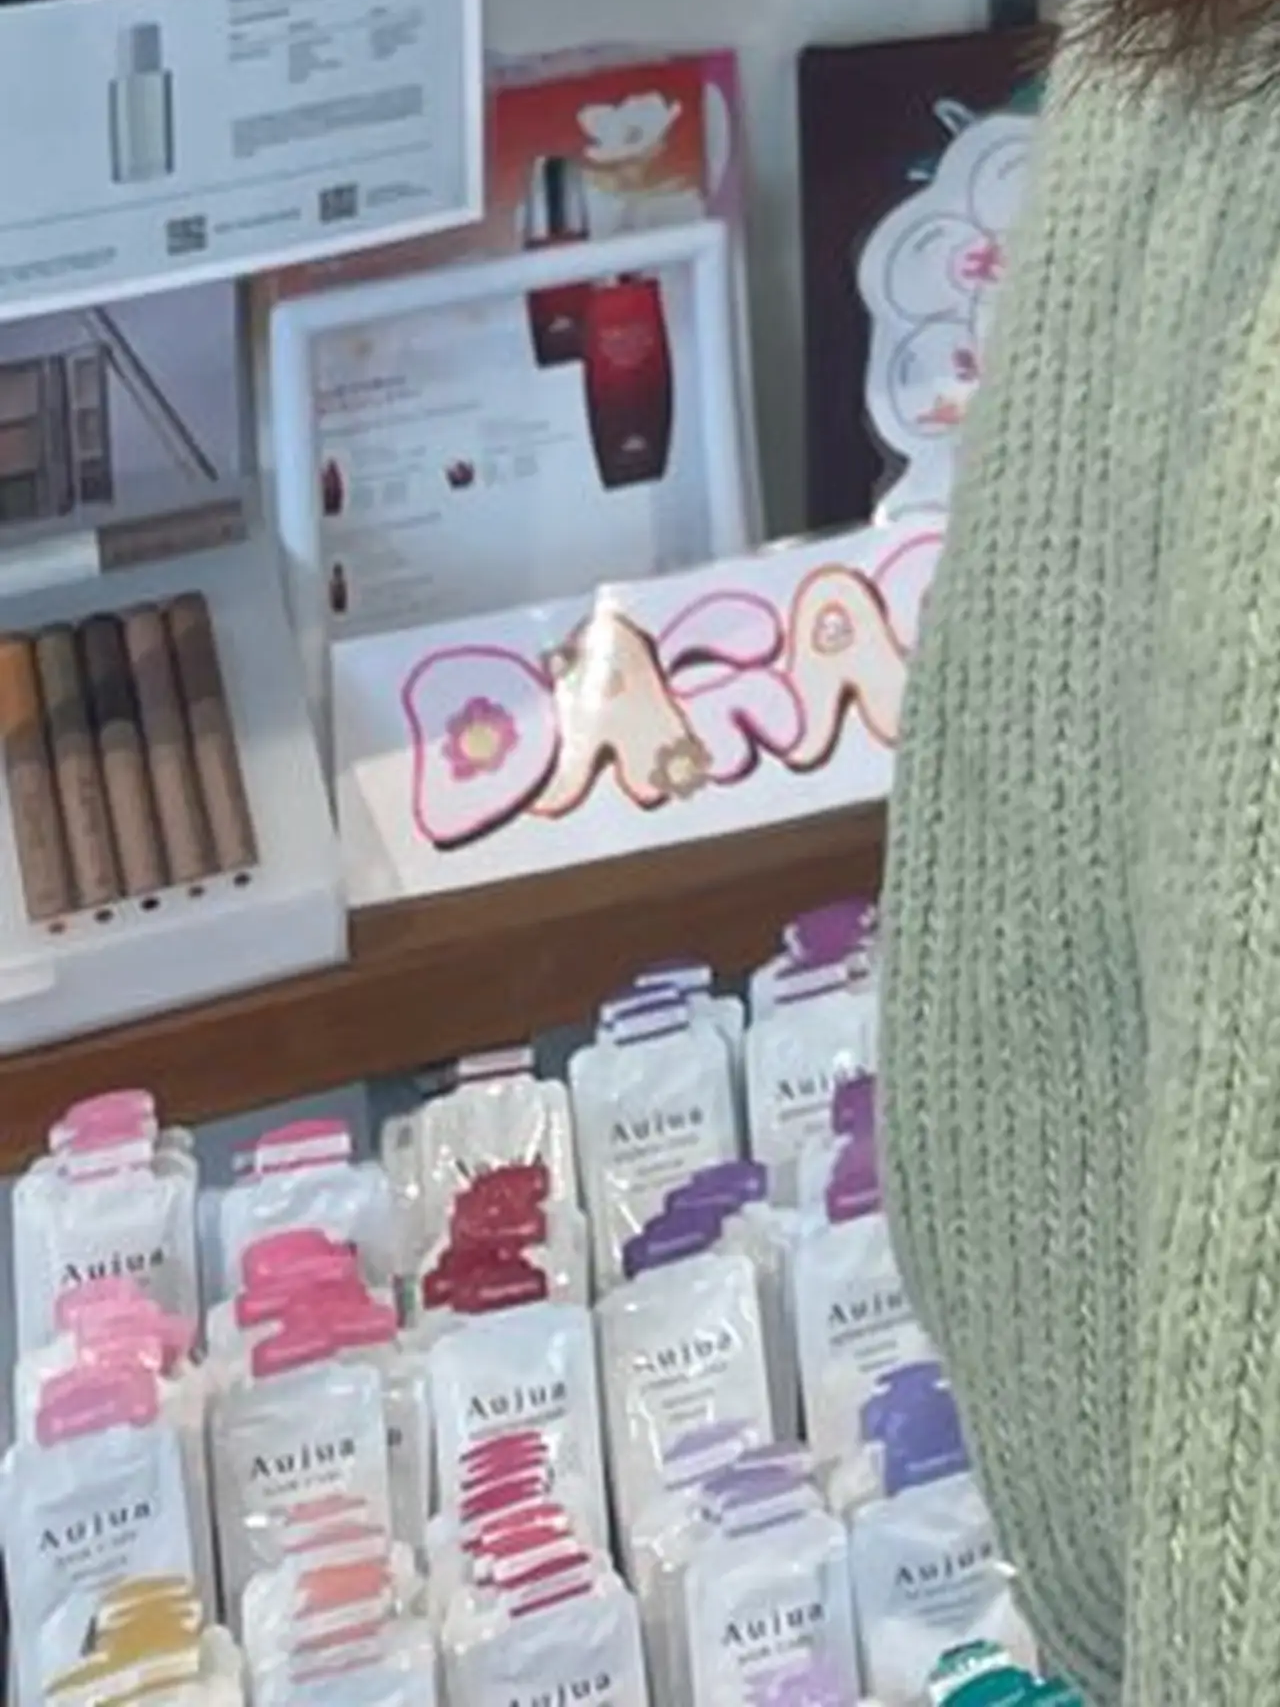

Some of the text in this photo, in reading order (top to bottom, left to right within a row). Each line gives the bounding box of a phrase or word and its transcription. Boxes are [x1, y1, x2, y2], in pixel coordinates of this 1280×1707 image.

[610, 1106, 704, 1145] Aujua
[60, 1247, 164, 1284] Aujua
[827, 1291, 904, 1329] Auju
[466, 1381, 566, 1422] Aujua
[250, 1438, 355, 1480] Aujua
[39, 1502, 151, 1551] Aujua
[895, 1540, 992, 1587] Aujua
[721, 1602, 825, 1648] Aujua
